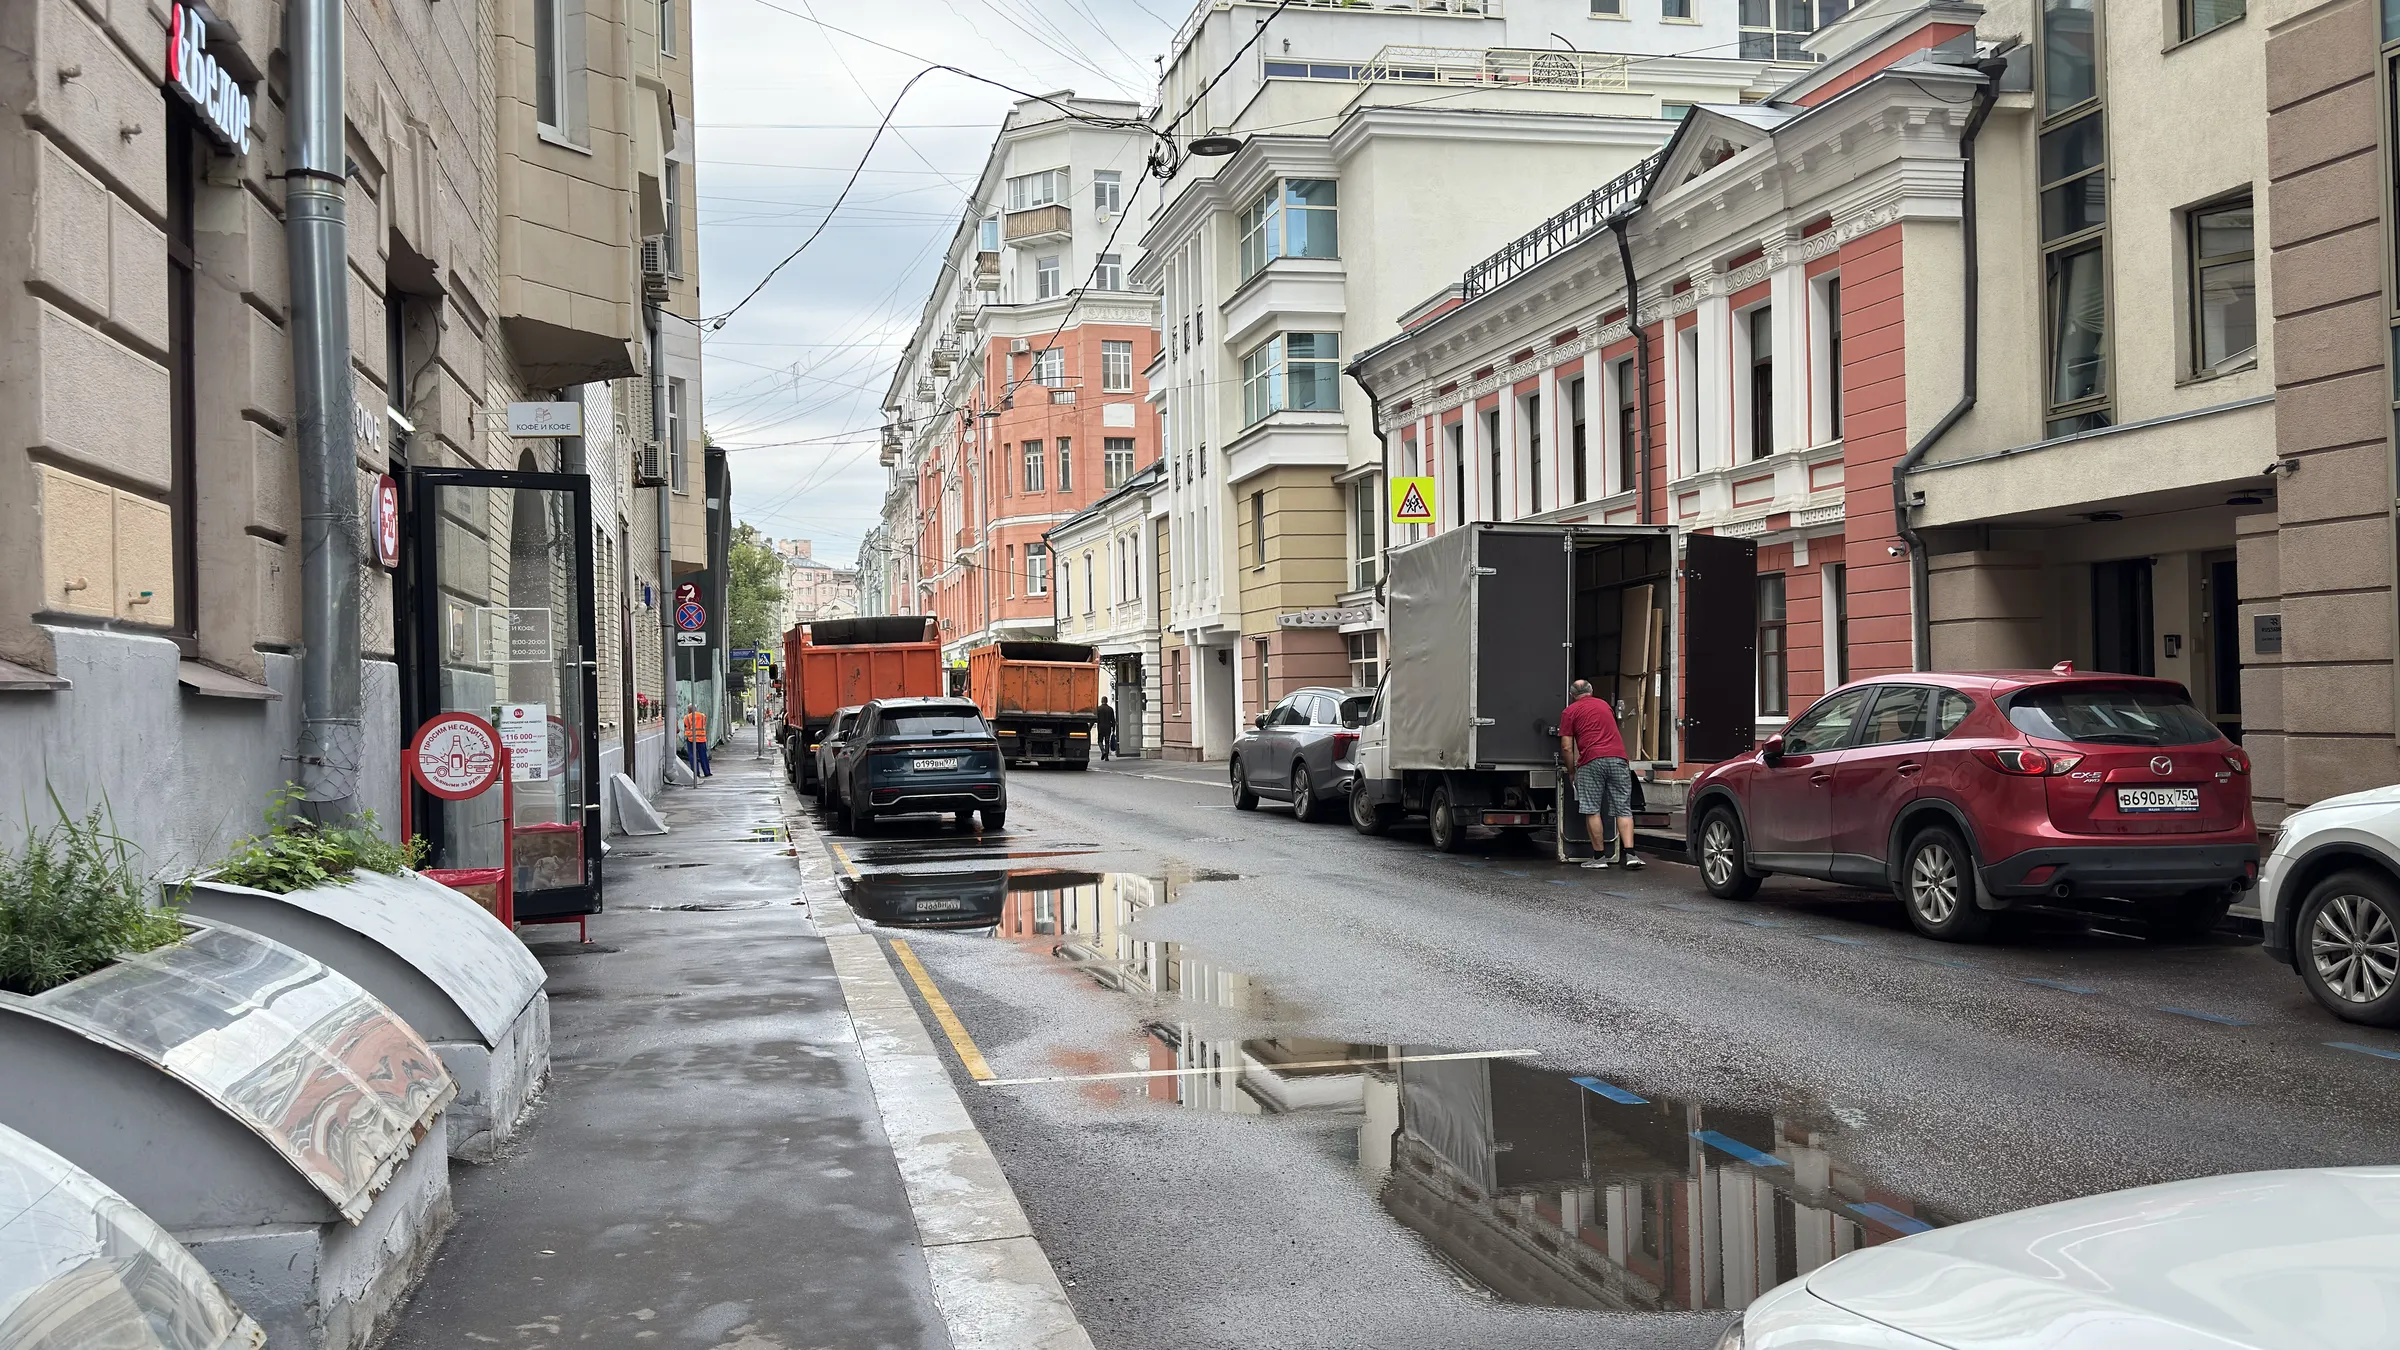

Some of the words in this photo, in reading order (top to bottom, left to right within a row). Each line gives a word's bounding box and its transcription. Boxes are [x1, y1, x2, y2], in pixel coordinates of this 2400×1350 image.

[355, 401, 381, 453] ОФЕ
[516, 423, 540, 431] КОФЕ
[540, 423, 547, 431] И
[548, 423, 571, 431] КОФЕ
[423, 726, 448, 751] ПРОСИМ
[459, 724, 490, 750] САДИТЬСЯ
[468, 775, 482, 787] руль
[2123, 791, 2174, 806] В690ВХ
[2175, 790, 2195, 801] 750
